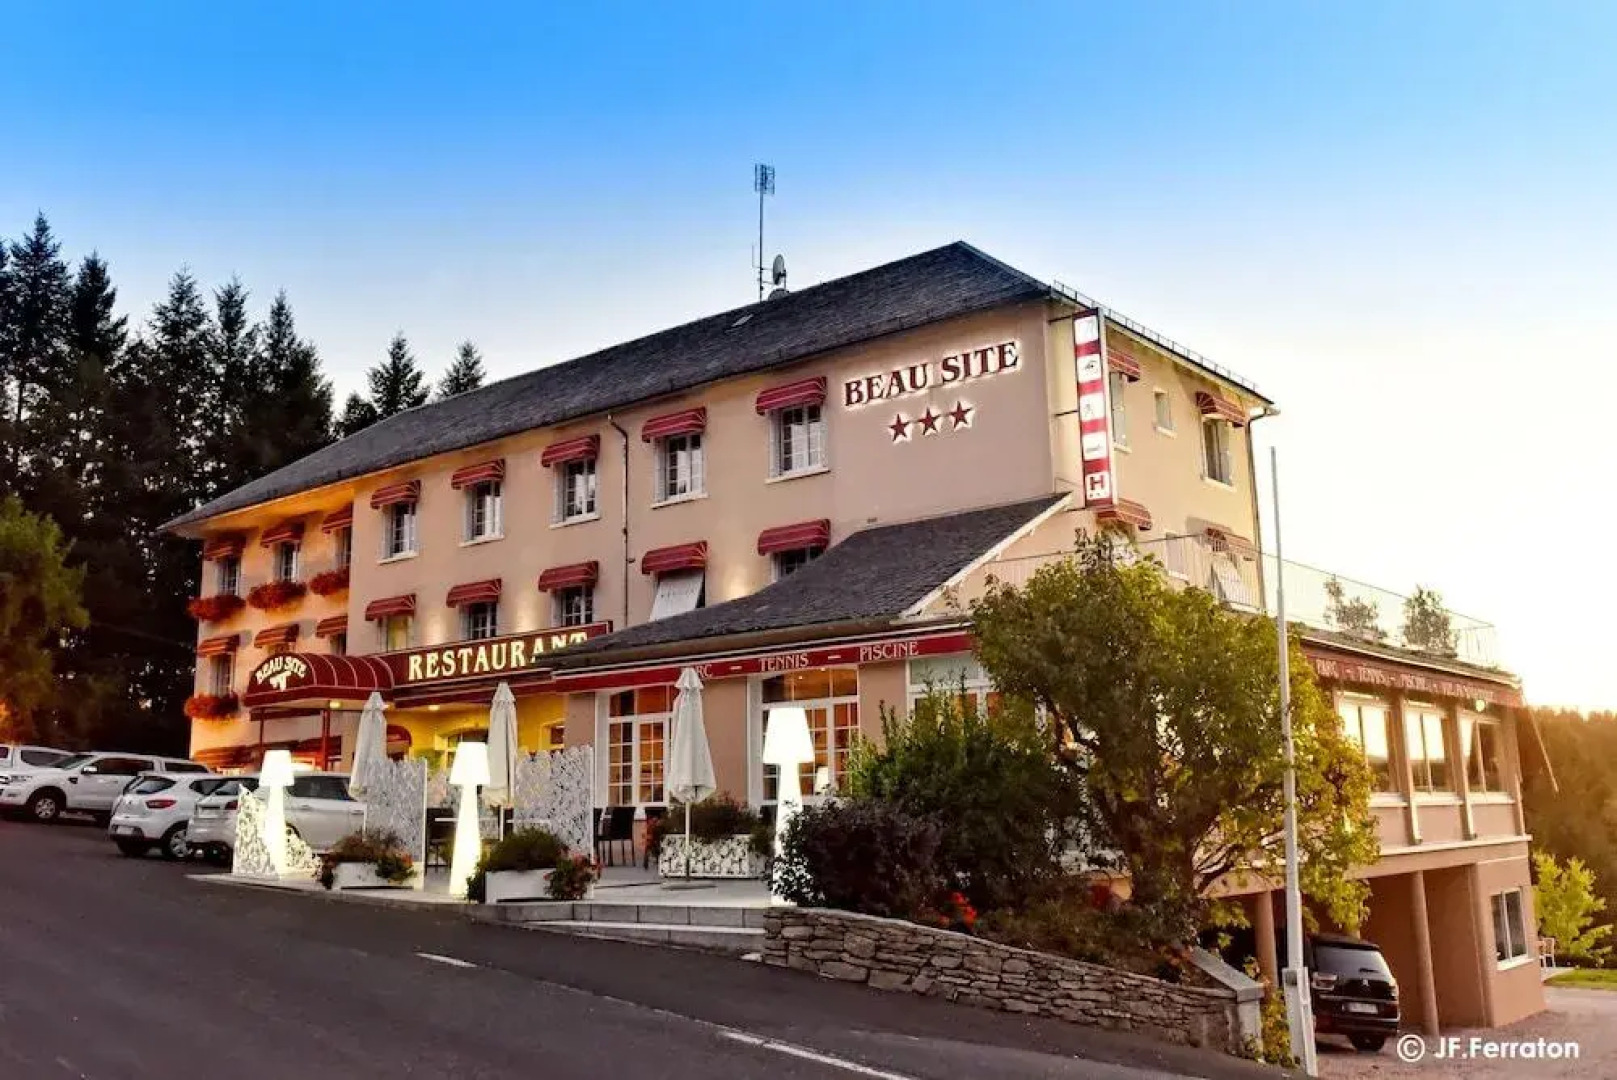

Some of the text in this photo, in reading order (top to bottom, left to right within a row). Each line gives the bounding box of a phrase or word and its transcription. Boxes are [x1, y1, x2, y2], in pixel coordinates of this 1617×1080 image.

[844, 341, 1019, 406] BEAU SITE
[759, 652, 810, 672] TENNIS
[859, 641, 920, 662] PISCINE
